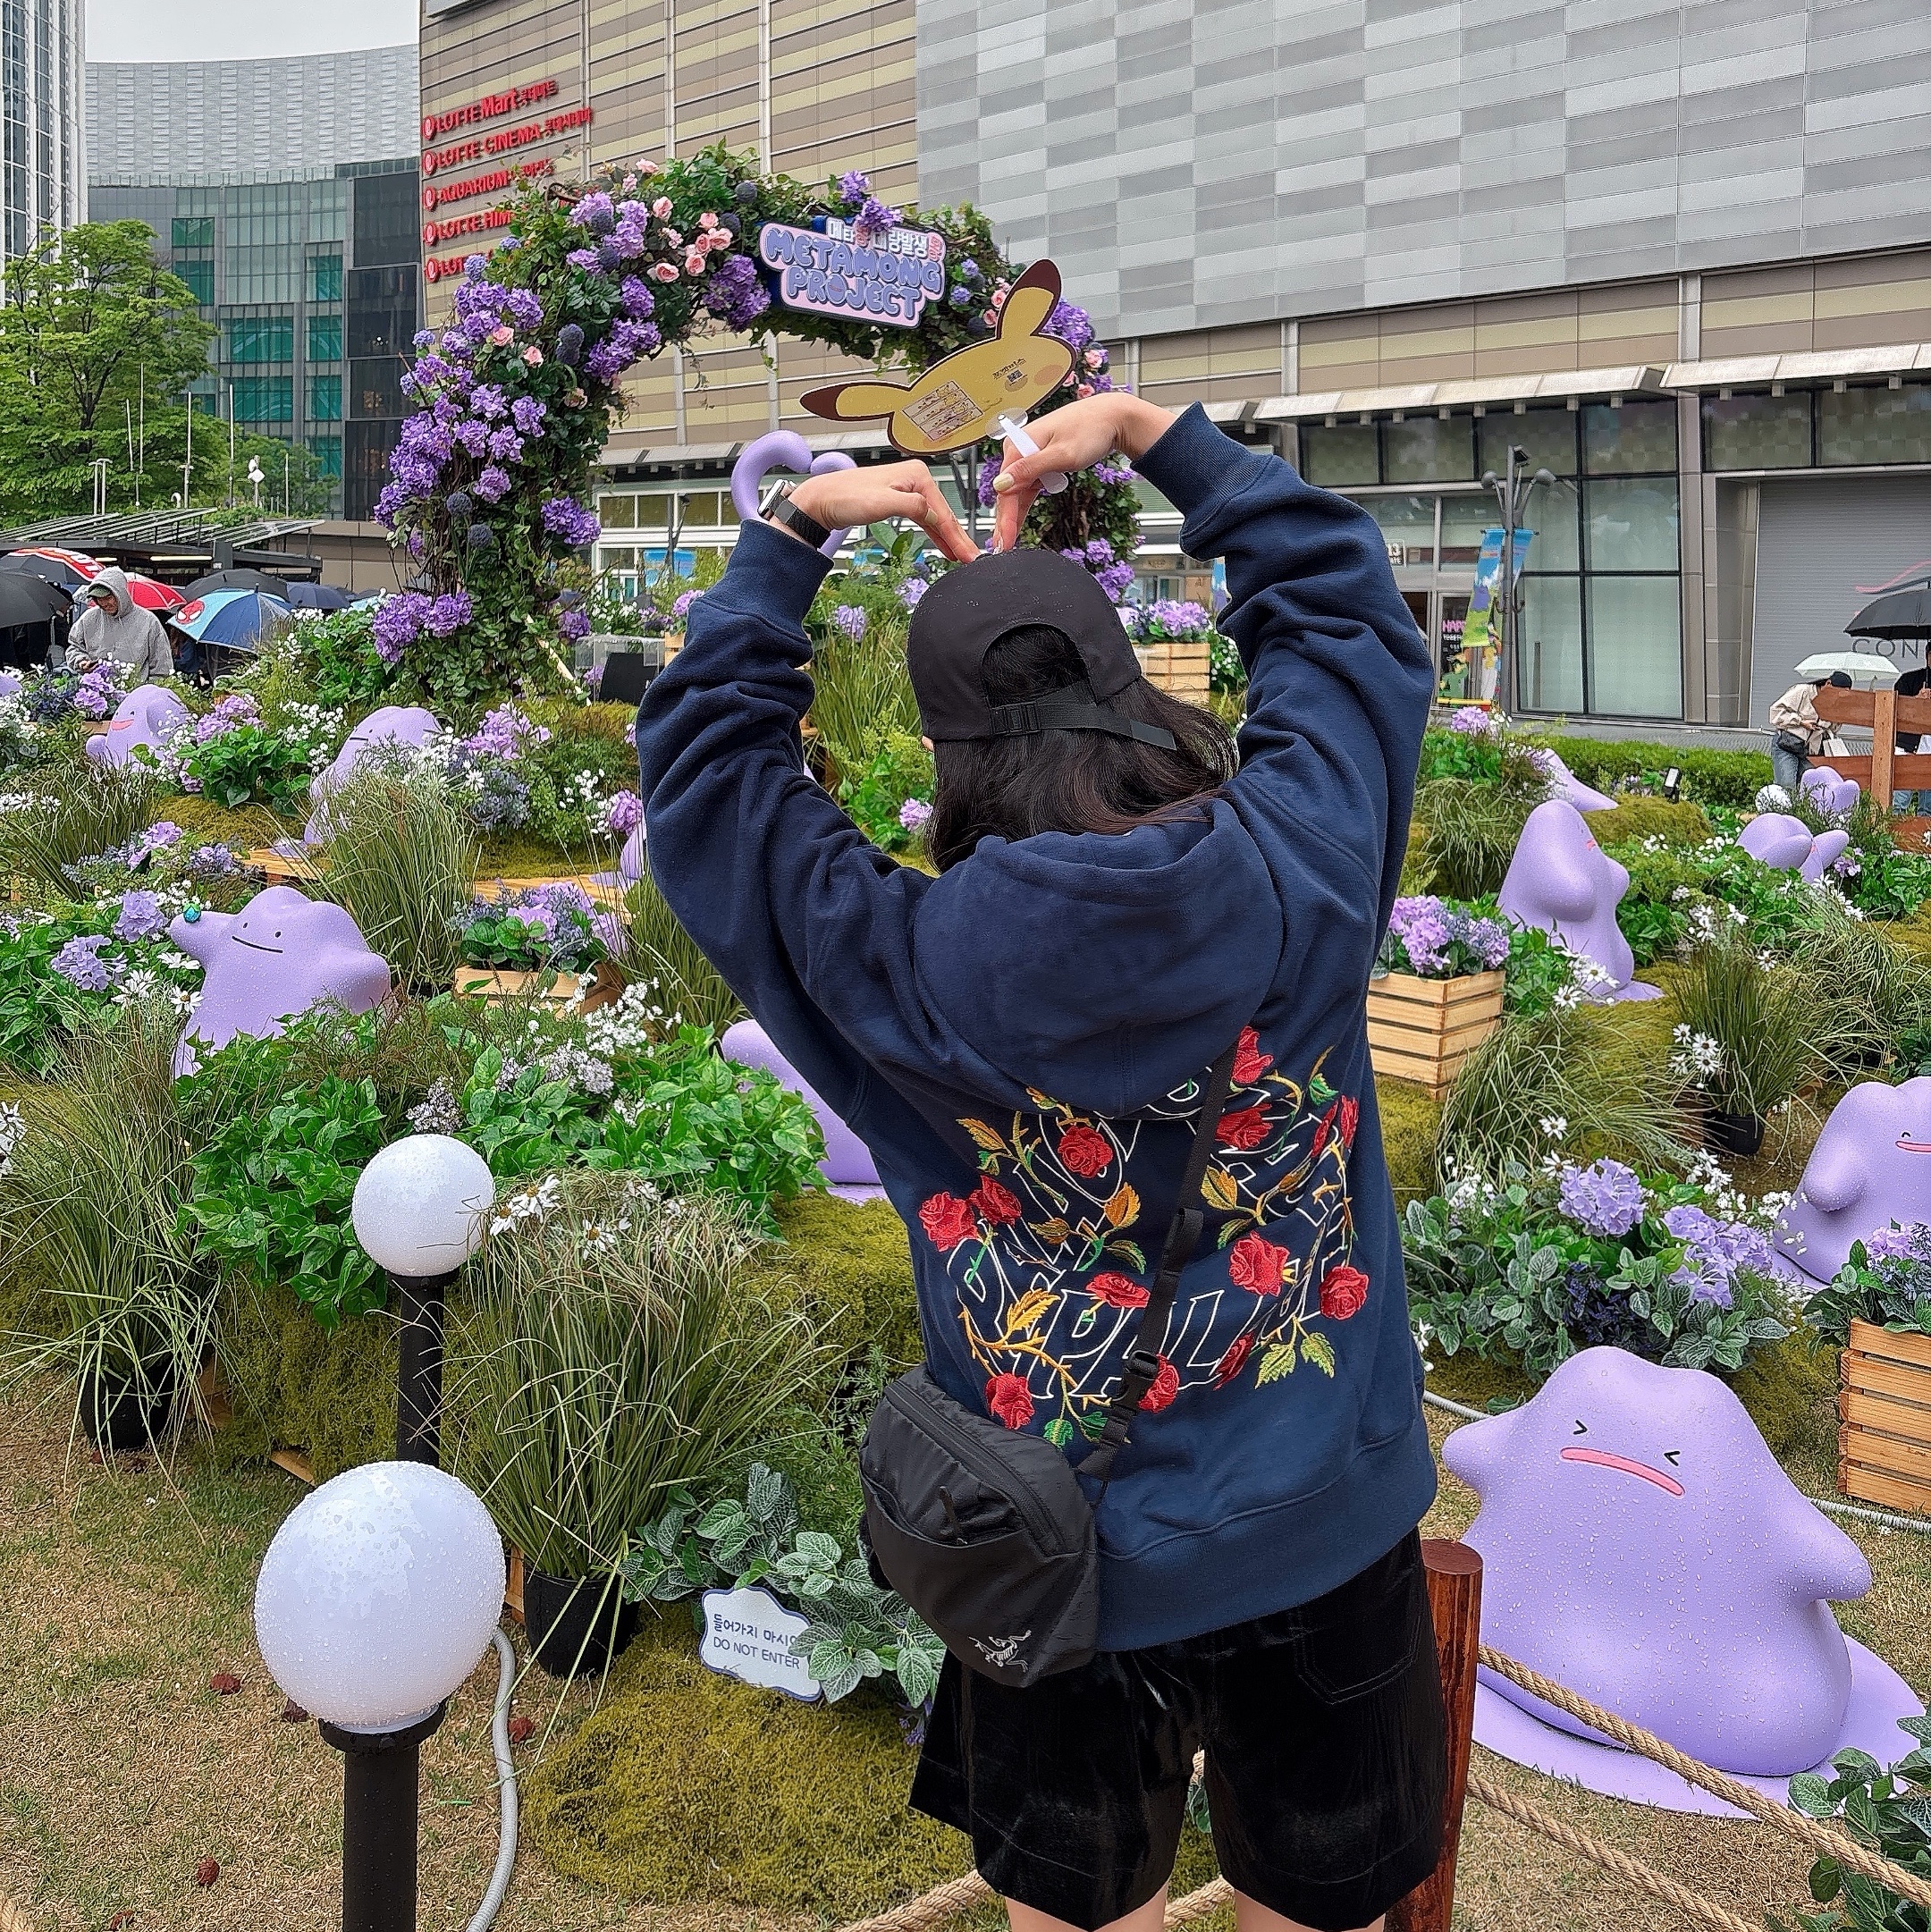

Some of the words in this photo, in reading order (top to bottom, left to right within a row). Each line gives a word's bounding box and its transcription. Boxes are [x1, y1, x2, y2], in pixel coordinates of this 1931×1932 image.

[436, 139, 480, 168] LOTTE
[484, 122, 542, 155] CINEMA
[543, 106, 593, 138] 롯데시네마
[438, 170, 509, 203] AQUARIUM
[437, 215, 481, 240] LOTTE
[484, 210, 510, 230] HIM
[439, 255, 465, 276] LOT
[765, 227, 942, 293] METAMONG
[786, 266, 921, 319] PROJECT
[1389, 556, 1403, 565] ATE
[1851, 638, 1919, 659] CON
[713, 1613, 758, 1639] 들어가지
[713, 1636, 730, 1650] DO
[733, 1642, 759, 1658] NOT
[762, 1649, 800, 1670] ENTER
